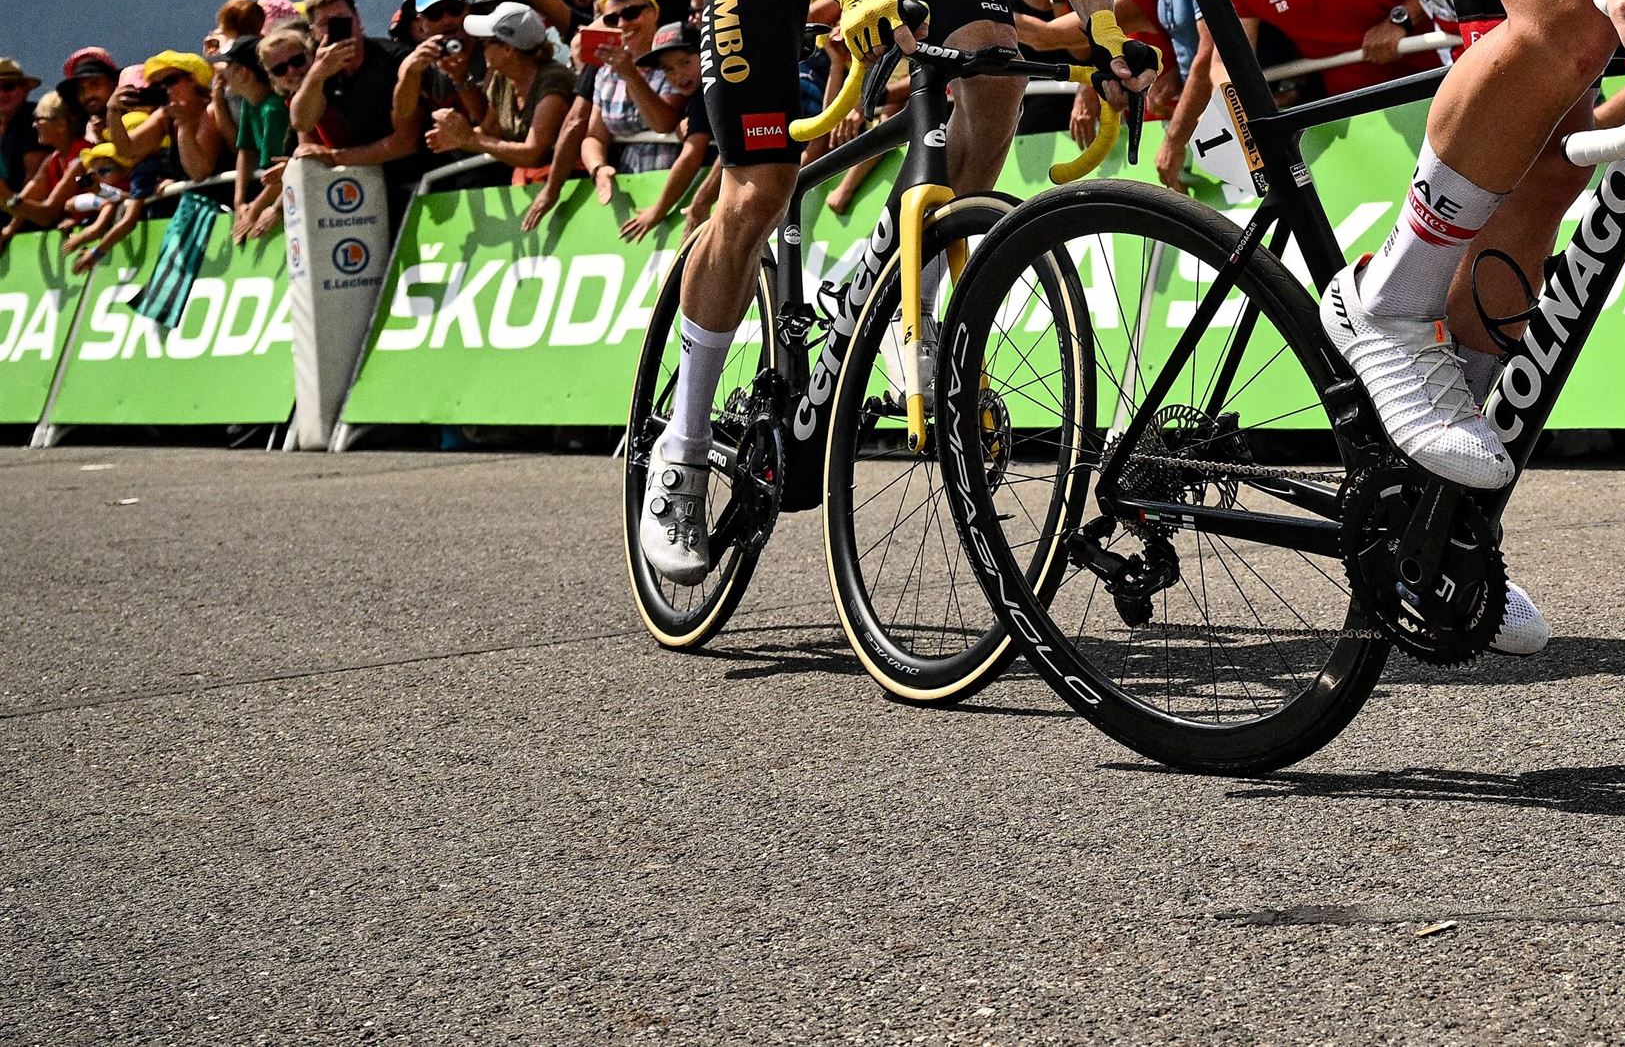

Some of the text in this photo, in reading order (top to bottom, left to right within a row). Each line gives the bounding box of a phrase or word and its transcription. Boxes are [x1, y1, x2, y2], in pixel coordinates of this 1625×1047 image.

[981, 2, 1009, 14] AGU
[746, 126, 783, 137] HEMA
[1195, 127, 1234, 159] 1
[376, 242, 676, 350] ŠKODA
[948, 322, 1103, 705] CAMPAGNOLO
[863, 630, 920, 676] DURA-ACE
